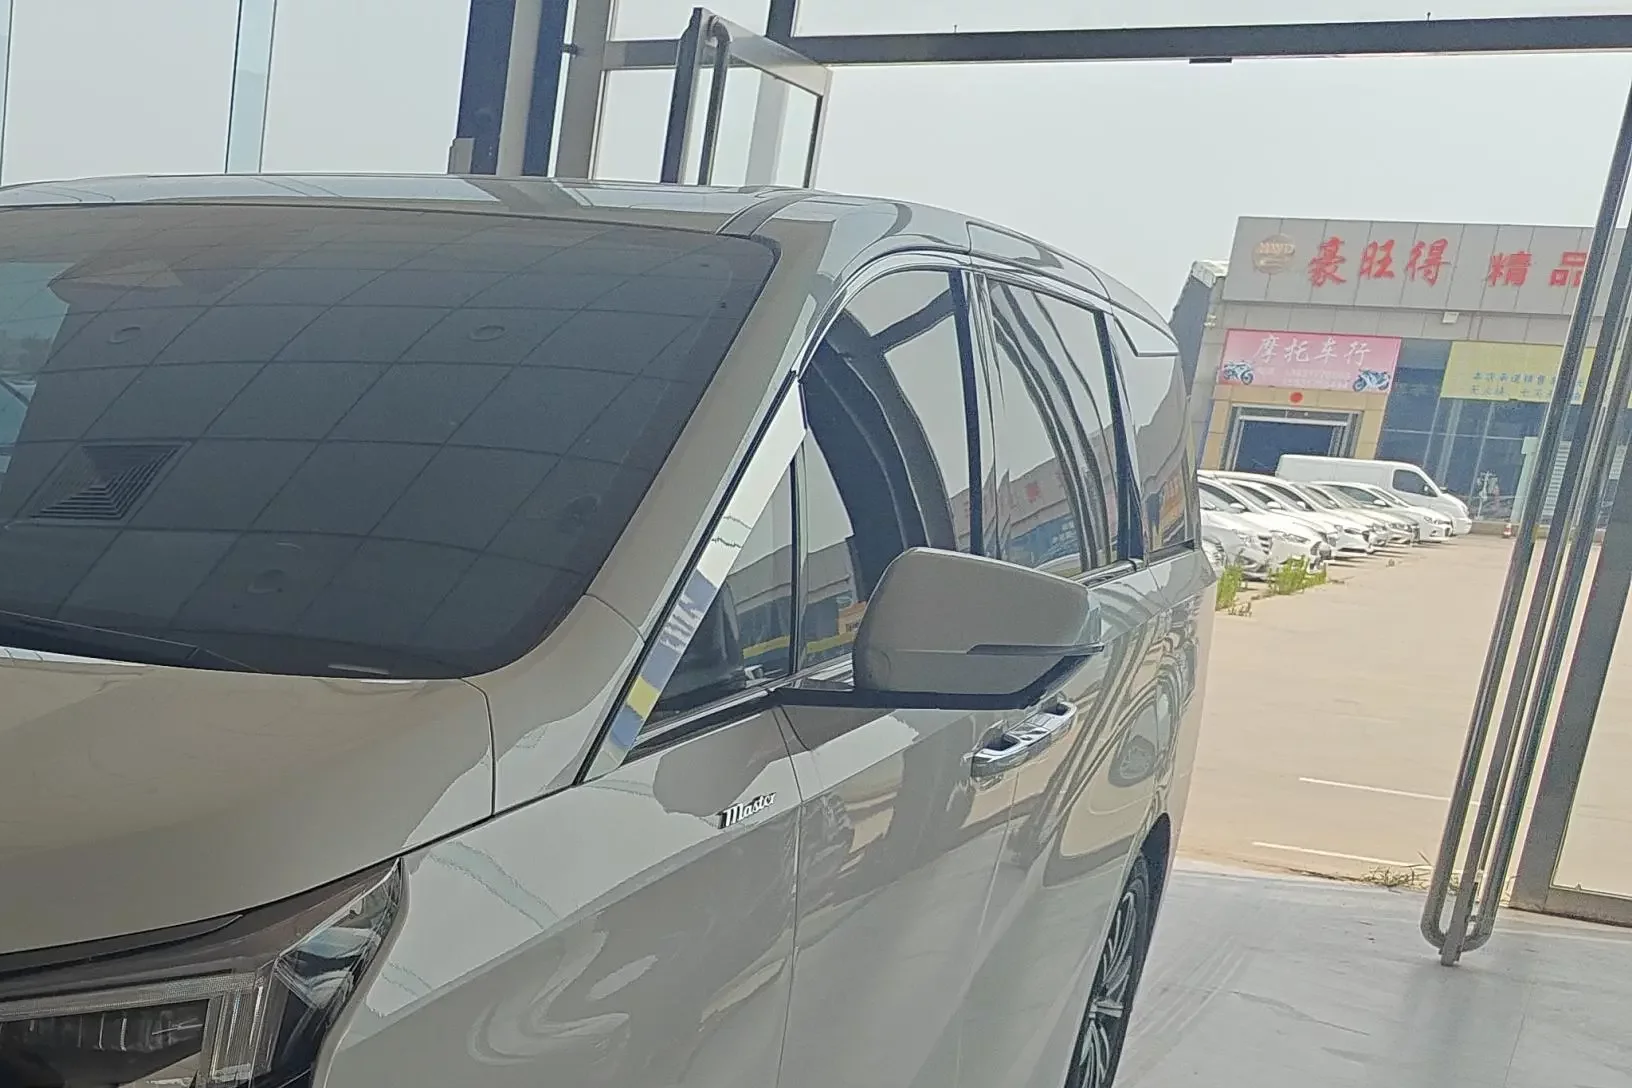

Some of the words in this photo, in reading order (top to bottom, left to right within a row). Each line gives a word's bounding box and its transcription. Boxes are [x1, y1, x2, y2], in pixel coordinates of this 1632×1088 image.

[1308, 236, 1452, 287] 豪旺得
[1486, 251, 1588, 287] 精品
[1253, 334, 1371, 366] 摩托车行
[717, 791, 777, 829] Master
